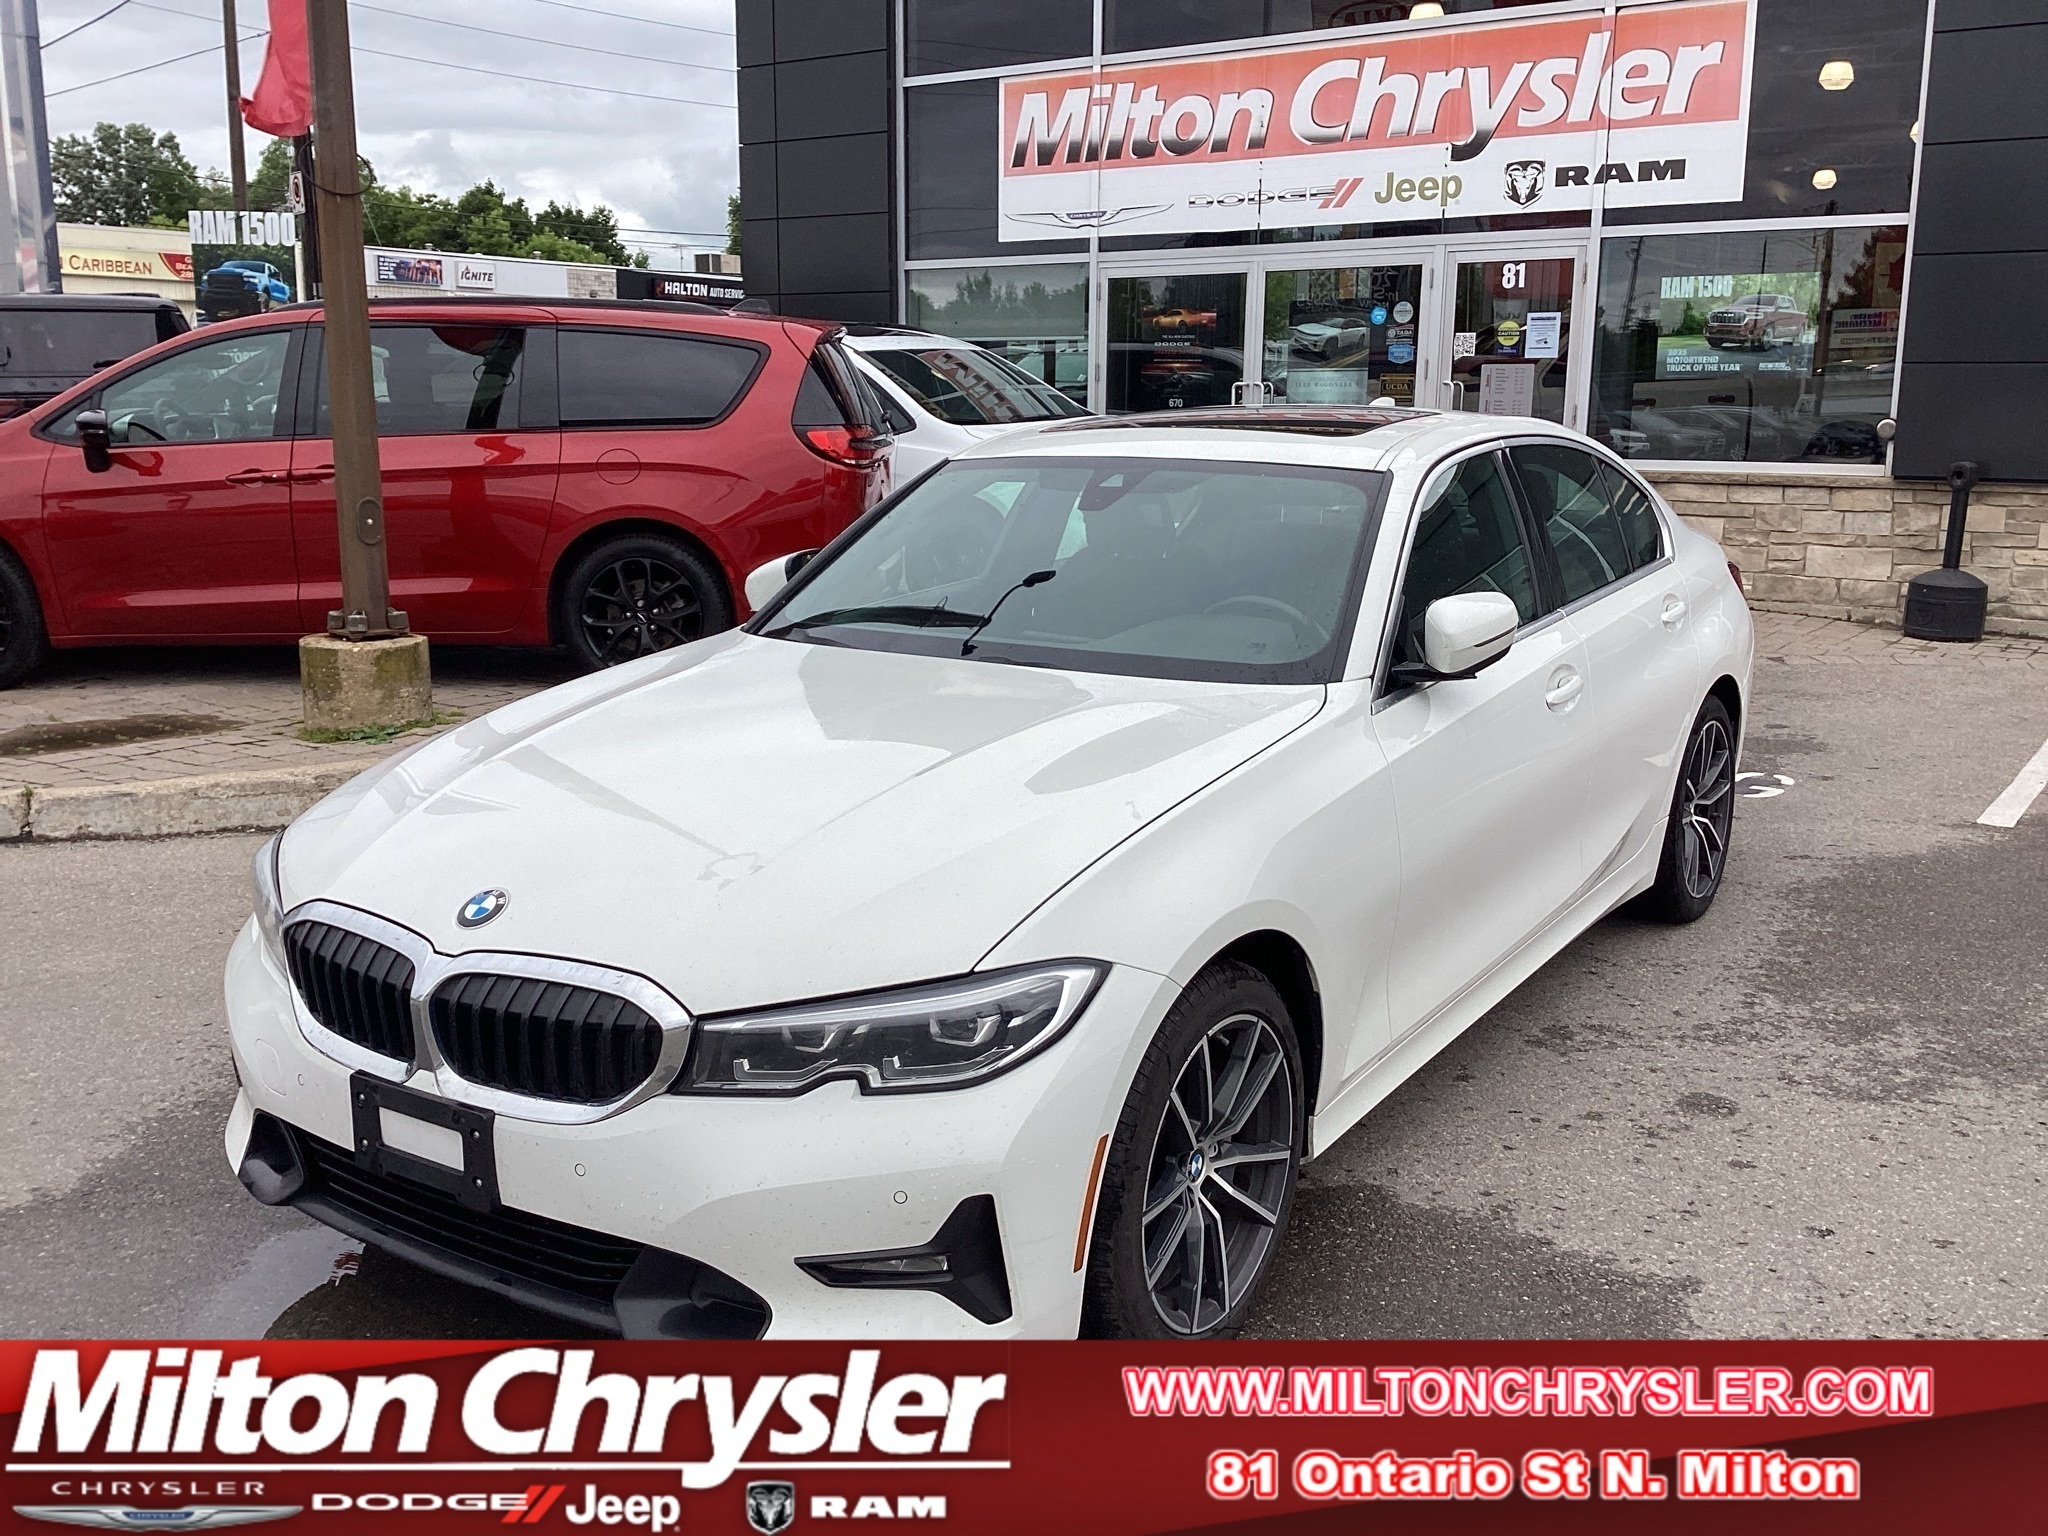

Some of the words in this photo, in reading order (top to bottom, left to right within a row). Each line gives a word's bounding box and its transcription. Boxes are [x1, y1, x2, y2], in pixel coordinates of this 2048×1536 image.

[1010, 81, 1275, 169] Milton
[1289, 30, 1726, 162] Chrysler
[1554, 158, 1687, 187] RAM
[1188, 185, 1338, 209] DODGE
[1374, 171, 1463, 207] Jeep
[187, 210, 237, 245] RAM
[239, 211, 296, 247] 1500
[68, 254, 152, 275] CARIBBEAN
[460, 270, 494, 282] IGNITE
[1501, 262, 1527, 290] 81
[664, 281, 708, 296] HALTON
[709, 287, 724, 297] AUTO
[724, 288, 745, 299] SERVIC
[1660, 275, 1695, 299] RAM
[1697, 274, 1733, 298] 1500
[1666, 356, 1719, 364] MOTORTREND
[1667, 348, 1688, 356] 2025
[1666, 364, 1692, 372] TRUCK
[1693, 364, 1703, 372] OF
[1704, 363, 1719, 371] THE
[1720, 363, 1741, 371] YEAR
[1314, 380, 1353, 388] WAGONEER
[1385, 383, 1409, 391] UCDA
[1168, 398, 1184, 408] 670
